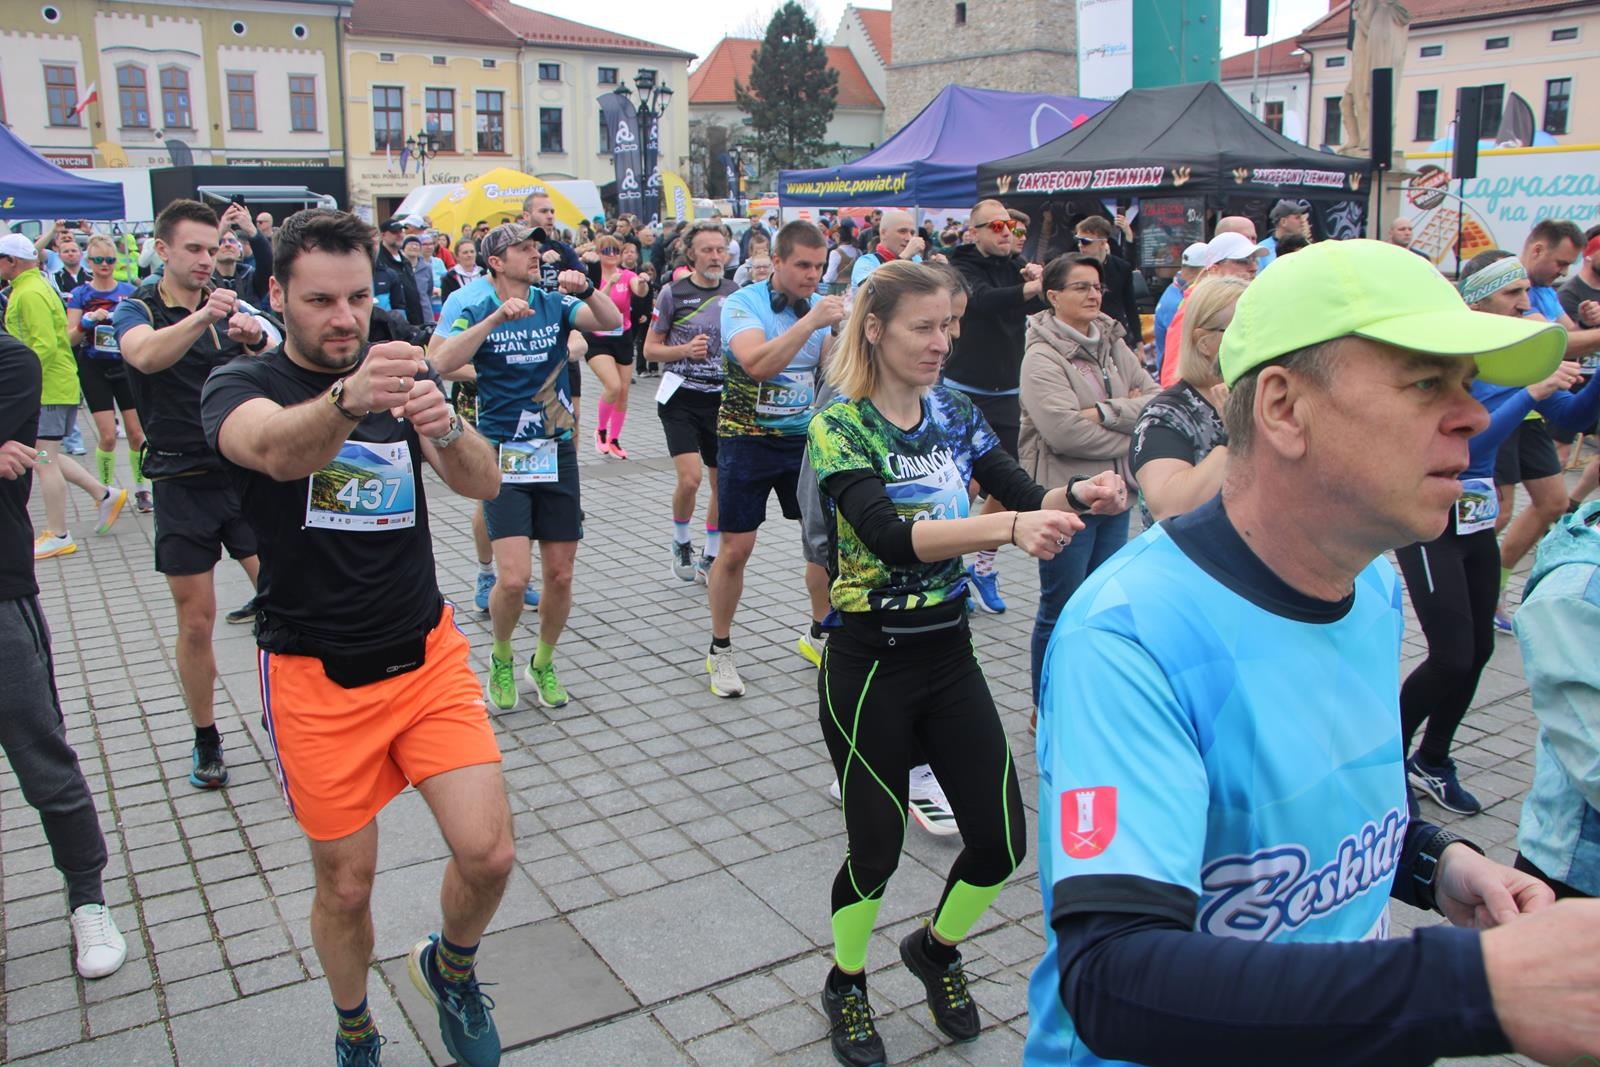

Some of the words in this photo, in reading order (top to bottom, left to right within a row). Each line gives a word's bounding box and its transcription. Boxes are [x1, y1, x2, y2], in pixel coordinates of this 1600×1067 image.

[429, 172, 460, 185] Sklep
[786, 172, 908, 197] www.zywiec.powiat.pl
[1017, 170, 1092, 193] ZAKRĘCONY
[1091, 167, 1164, 189] ZIEMNIAK
[1455, 174, 1600, 214] aprasza
[1499, 205, 1528, 221] na
[531, 322, 560, 339] ALPS
[493, 341, 528, 353] TRAIL
[529, 336, 557, 351] RUN
[767, 389, 808, 405] 1596
[507, 455, 550, 472] 1184
[336, 477, 401, 510] 437
